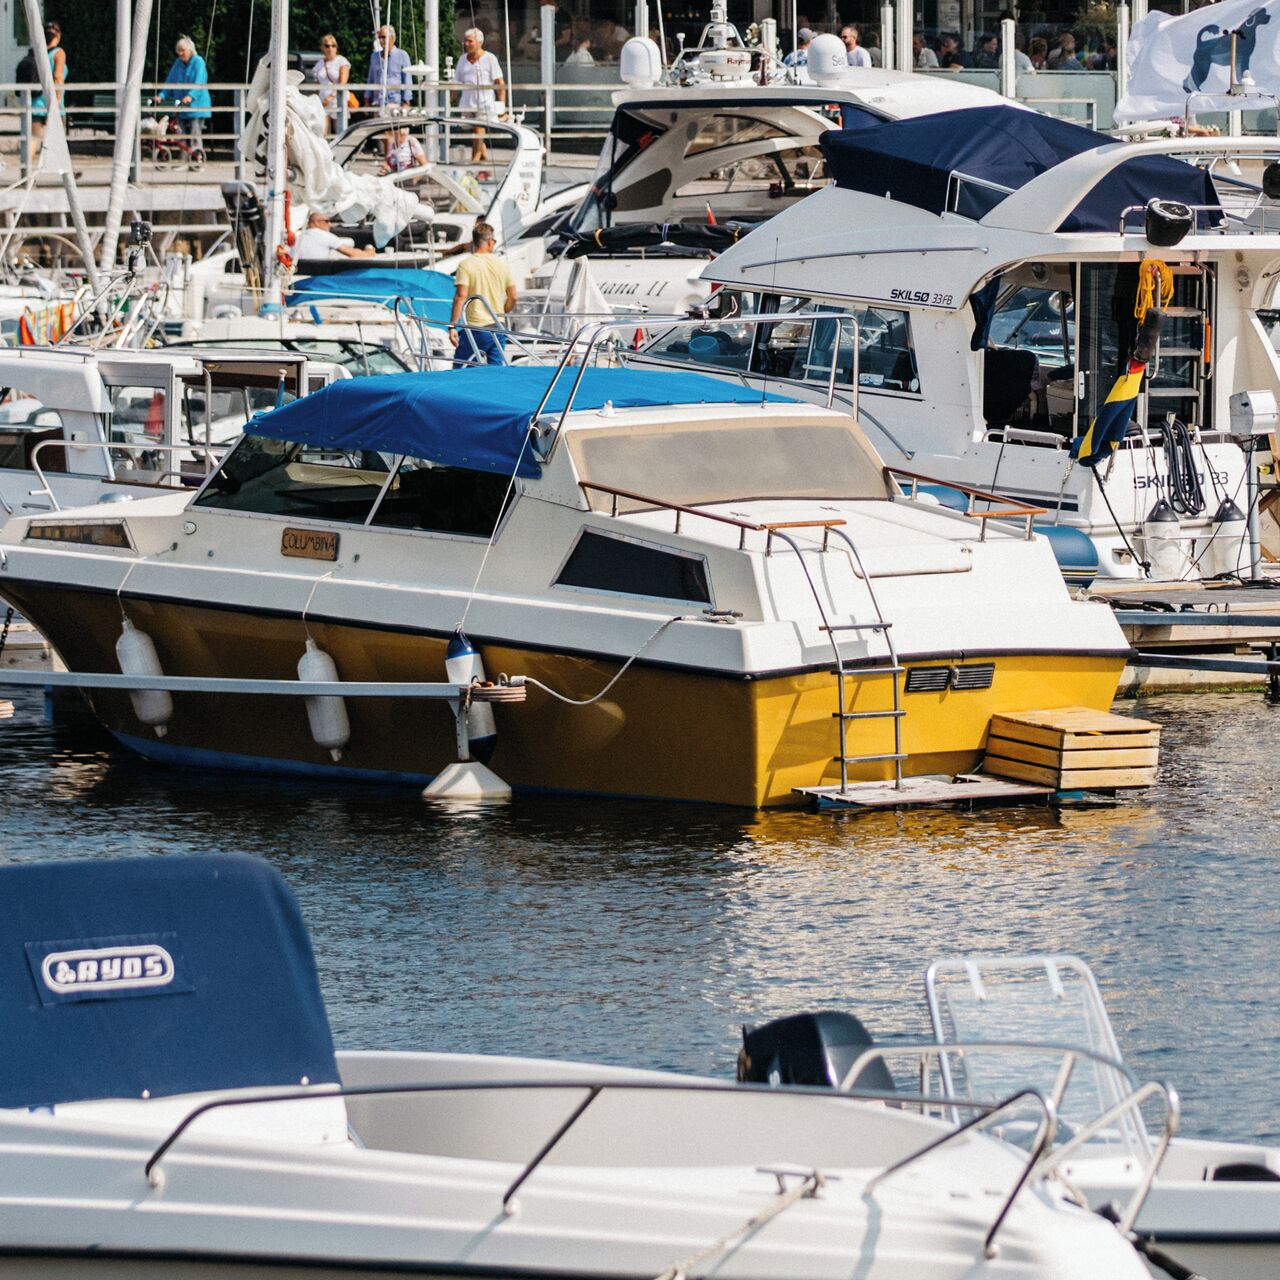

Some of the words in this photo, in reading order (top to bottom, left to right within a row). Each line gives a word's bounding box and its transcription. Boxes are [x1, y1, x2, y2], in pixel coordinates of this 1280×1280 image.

[890, 289, 930, 302] SKILSØ
[282, 533, 336, 551] COLUMBINA
[77, 955, 164, 982] RYDS
